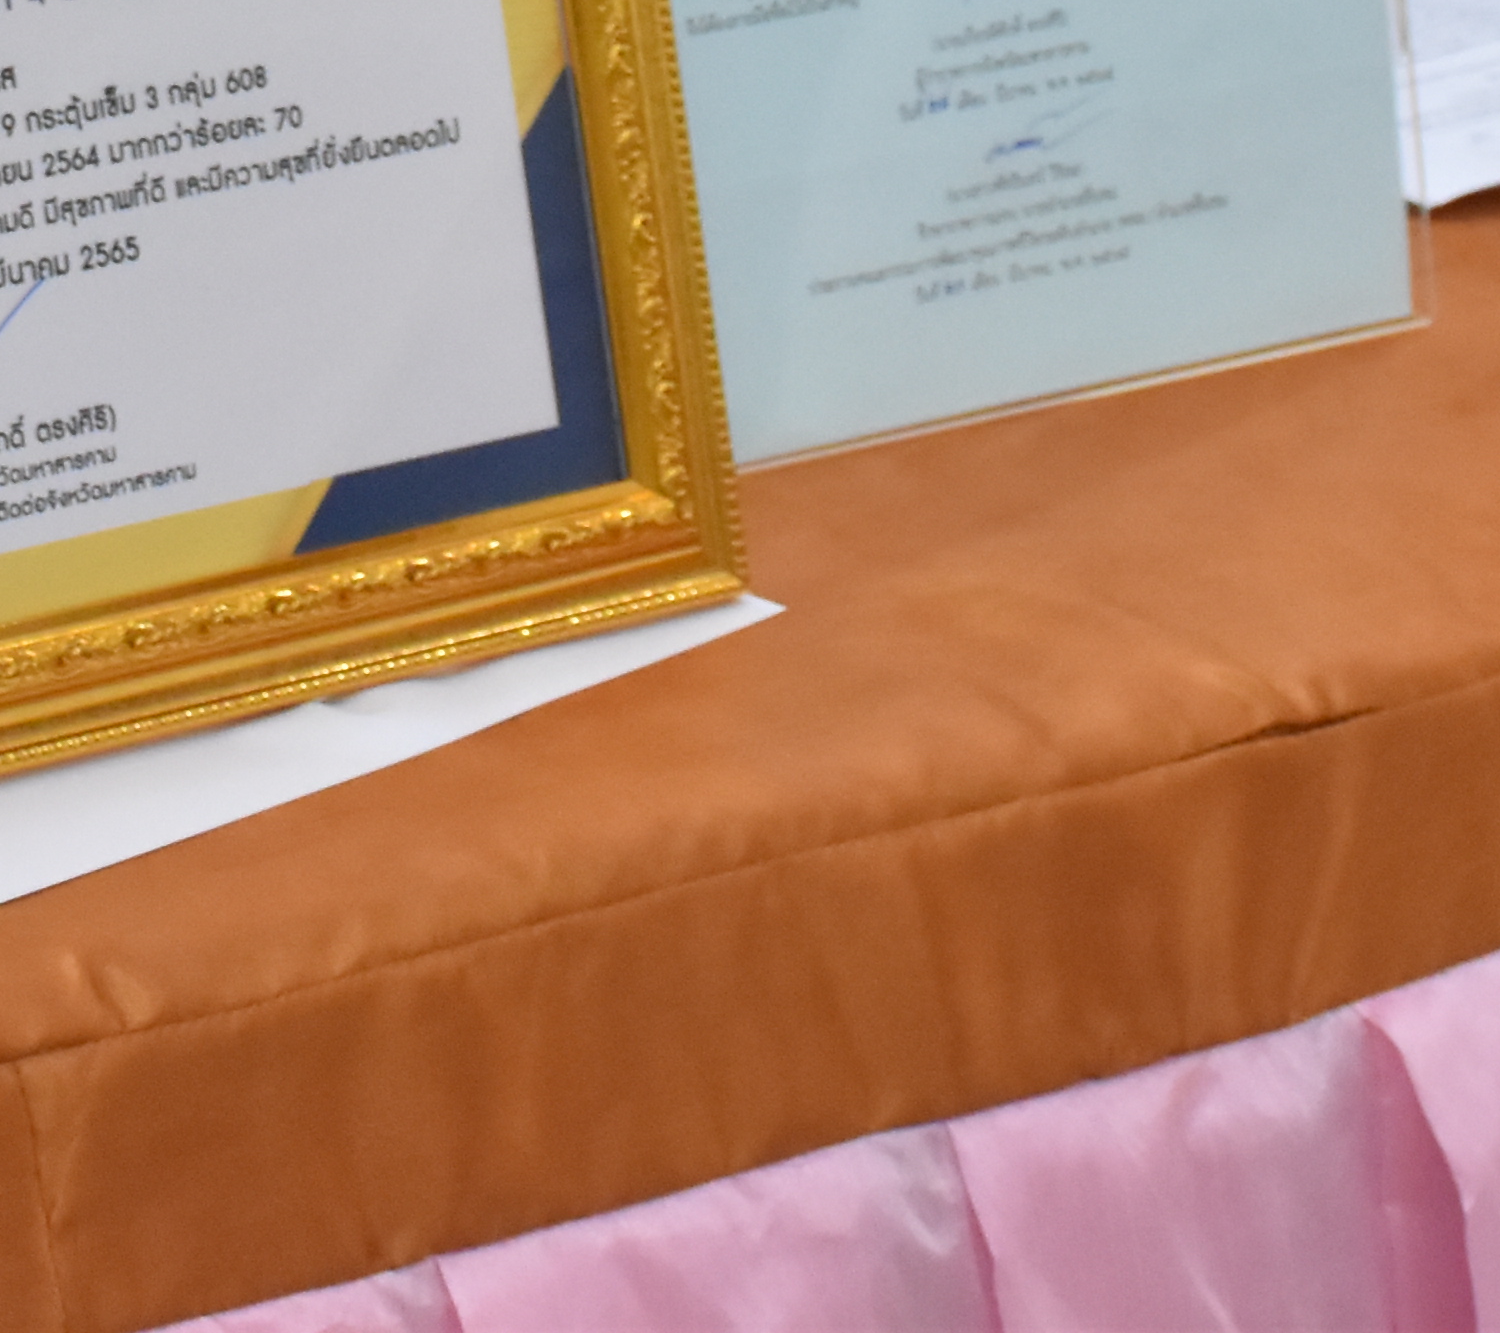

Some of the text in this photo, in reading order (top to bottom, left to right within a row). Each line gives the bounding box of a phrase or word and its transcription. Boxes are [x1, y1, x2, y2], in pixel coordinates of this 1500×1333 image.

[145, 85, 159, 110] 3
[225, 65, 267, 94] 608
[42, 145, 100, 177] 2564
[274, 104, 303, 131] 70
[80, 236, 140, 271] 2565
